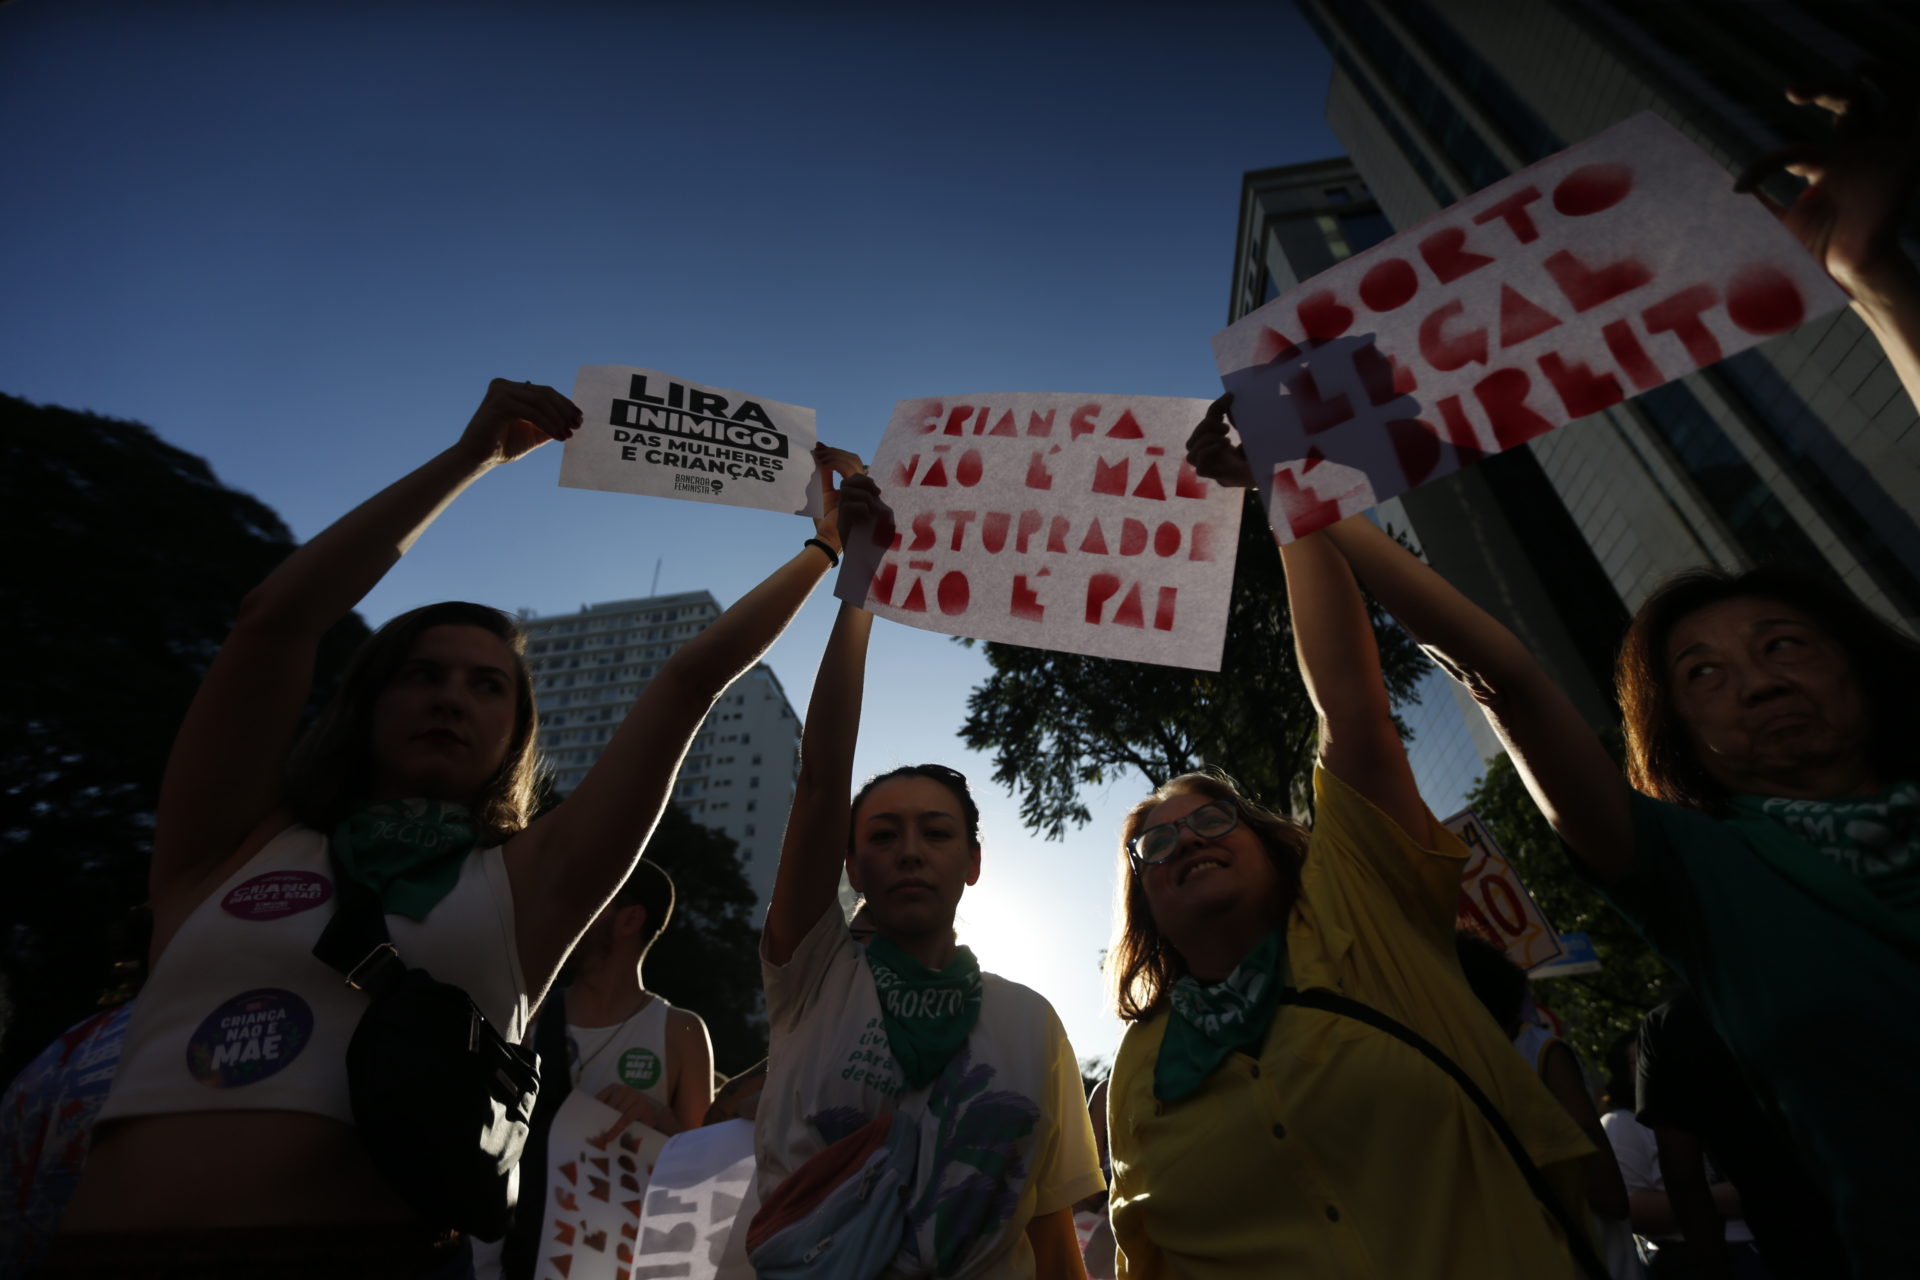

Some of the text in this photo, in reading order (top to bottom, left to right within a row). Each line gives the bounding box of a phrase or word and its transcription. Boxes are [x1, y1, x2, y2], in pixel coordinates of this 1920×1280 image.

[1252, 163, 1634, 372] ABORTO
[1288, 249, 1655, 436] LEGAL
[1385, 263, 1804, 490] DIREITO
[629, 374, 778, 431] LIRA
[916, 402, 1144, 441] CRIANÇA
[613, 429, 784, 472] DAS MULHERES
[626, 405, 781, 451] INIMIGO
[621, 446, 776, 483] E CRIANÇAS
[674, 473, 710, 487] BANCADA
[892, 444, 1209, 501] NÃO É MÃE
[674, 482, 710, 495] FEMINISTA
[871, 560, 1178, 632] NÃO É PAI
[848, 1050, 894, 1072] para
